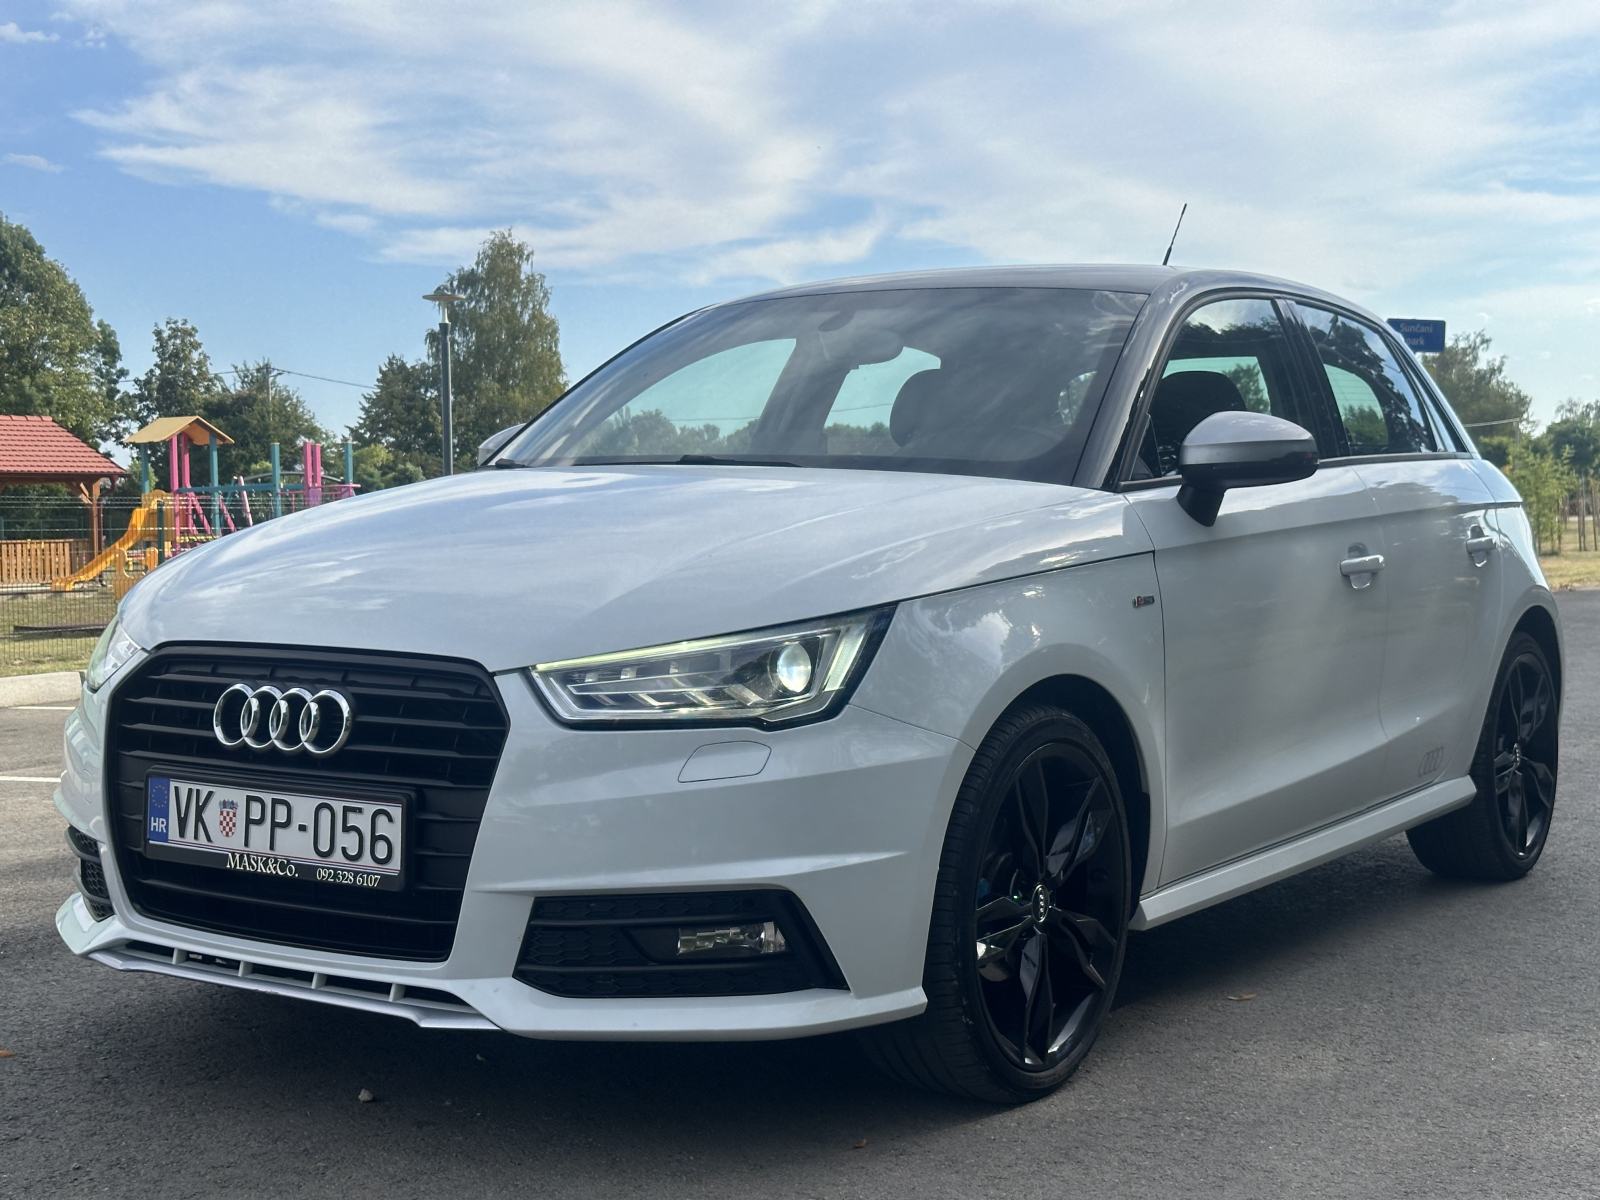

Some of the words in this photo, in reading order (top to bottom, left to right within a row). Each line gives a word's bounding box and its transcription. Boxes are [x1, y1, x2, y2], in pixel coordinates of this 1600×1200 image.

[150, 816, 167, 833] HR
[174, 786, 214, 842] VK
[243, 794, 393, 864] PP-056
[226, 852, 299, 877] MASK&Co.
[316, 867, 334, 881] 092
[335, 870, 354, 884] 328
[356, 873, 381, 887] 6107
